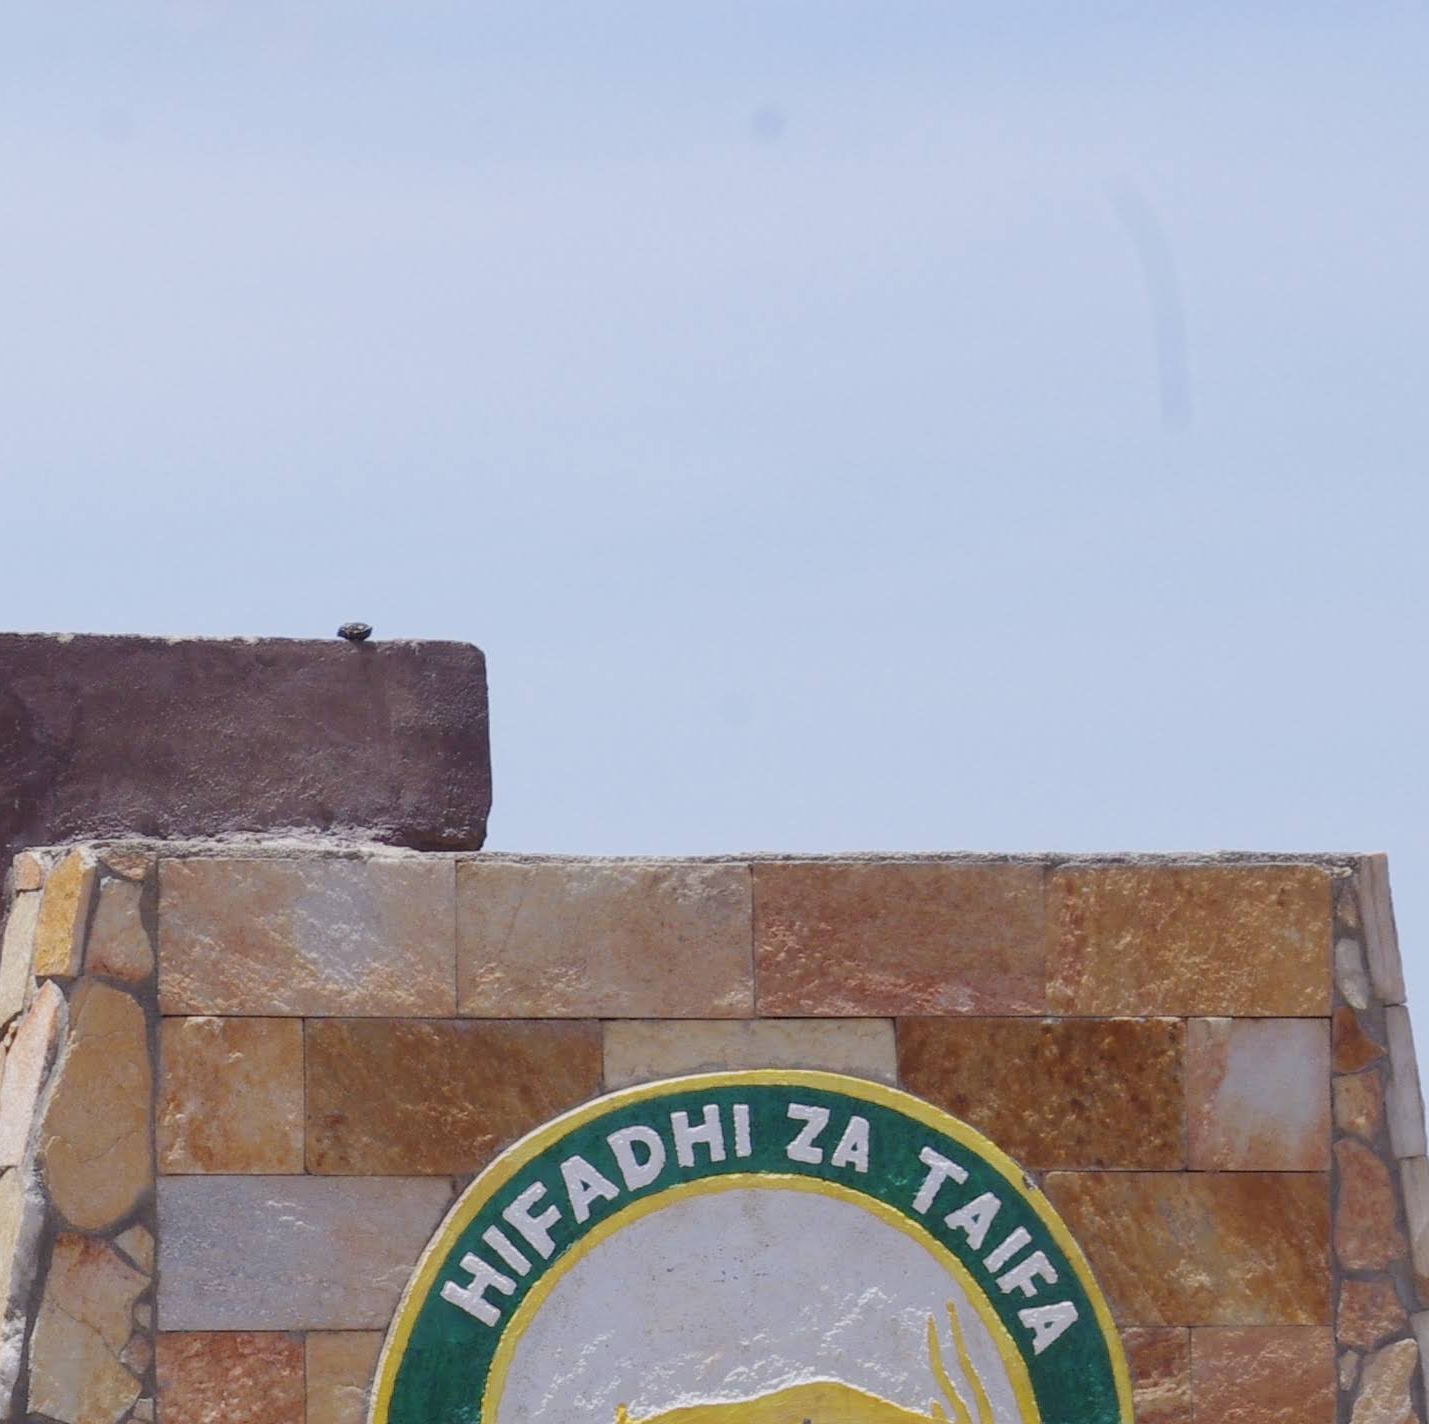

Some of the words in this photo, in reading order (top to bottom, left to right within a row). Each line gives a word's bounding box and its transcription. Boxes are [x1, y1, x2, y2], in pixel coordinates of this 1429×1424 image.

[440, 1103, 752, 1328] HIFADHI
[785, 1103, 871, 1174] ZA
[910, 1146, 1079, 1355] TAIFA
